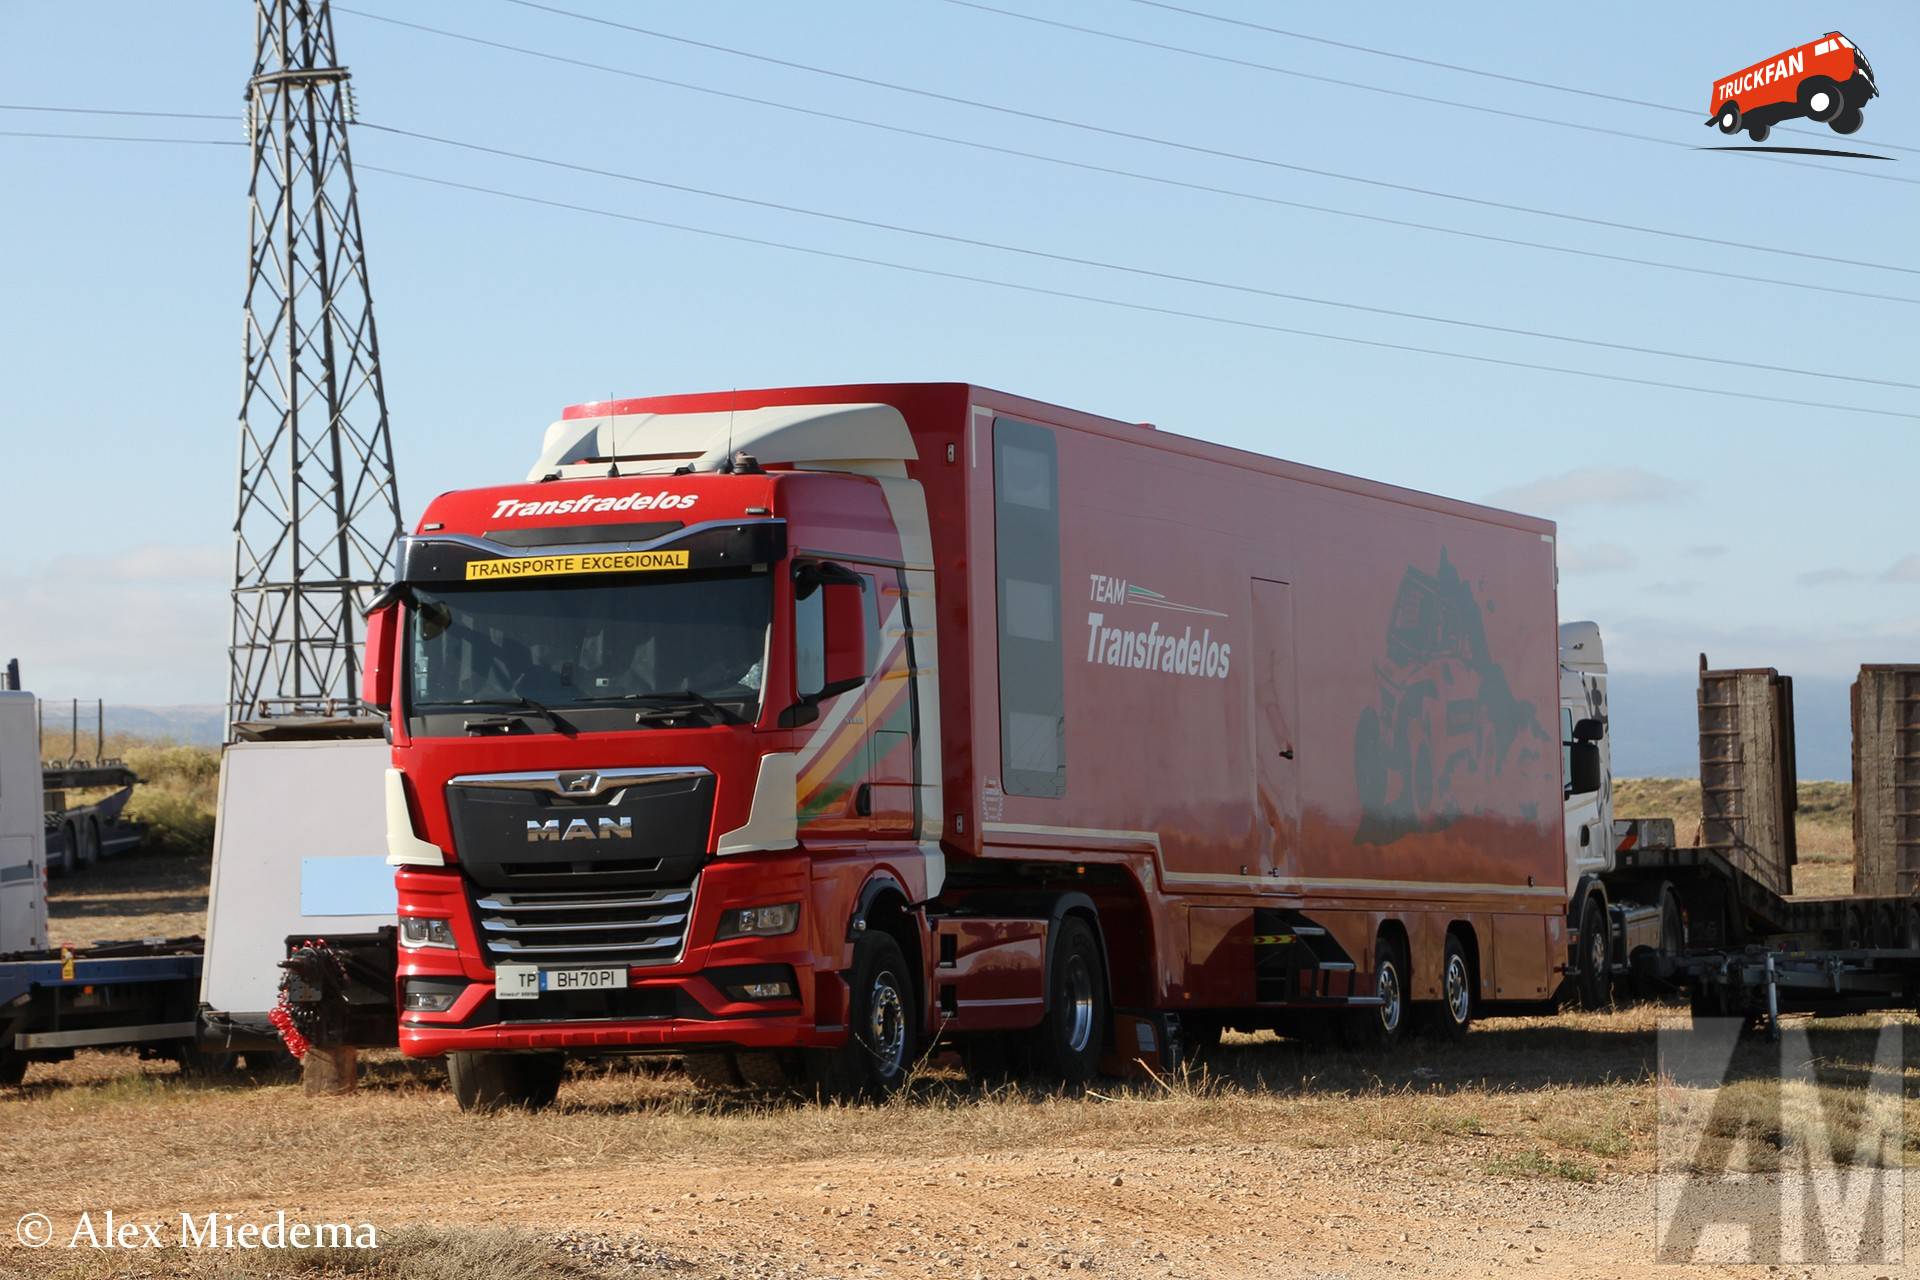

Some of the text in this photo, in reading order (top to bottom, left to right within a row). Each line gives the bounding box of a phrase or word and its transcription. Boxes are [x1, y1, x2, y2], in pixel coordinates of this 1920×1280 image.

[491, 491, 698, 519] Transfradelos
[470, 554, 685, 577] TRANSPORTE EXCECIONAL
[1090, 574, 1126, 605] TEAM
[1087, 612, 1231, 678] Transfradelos
[527, 817, 633, 842] MAN
[518, 973, 537, 988] TP
